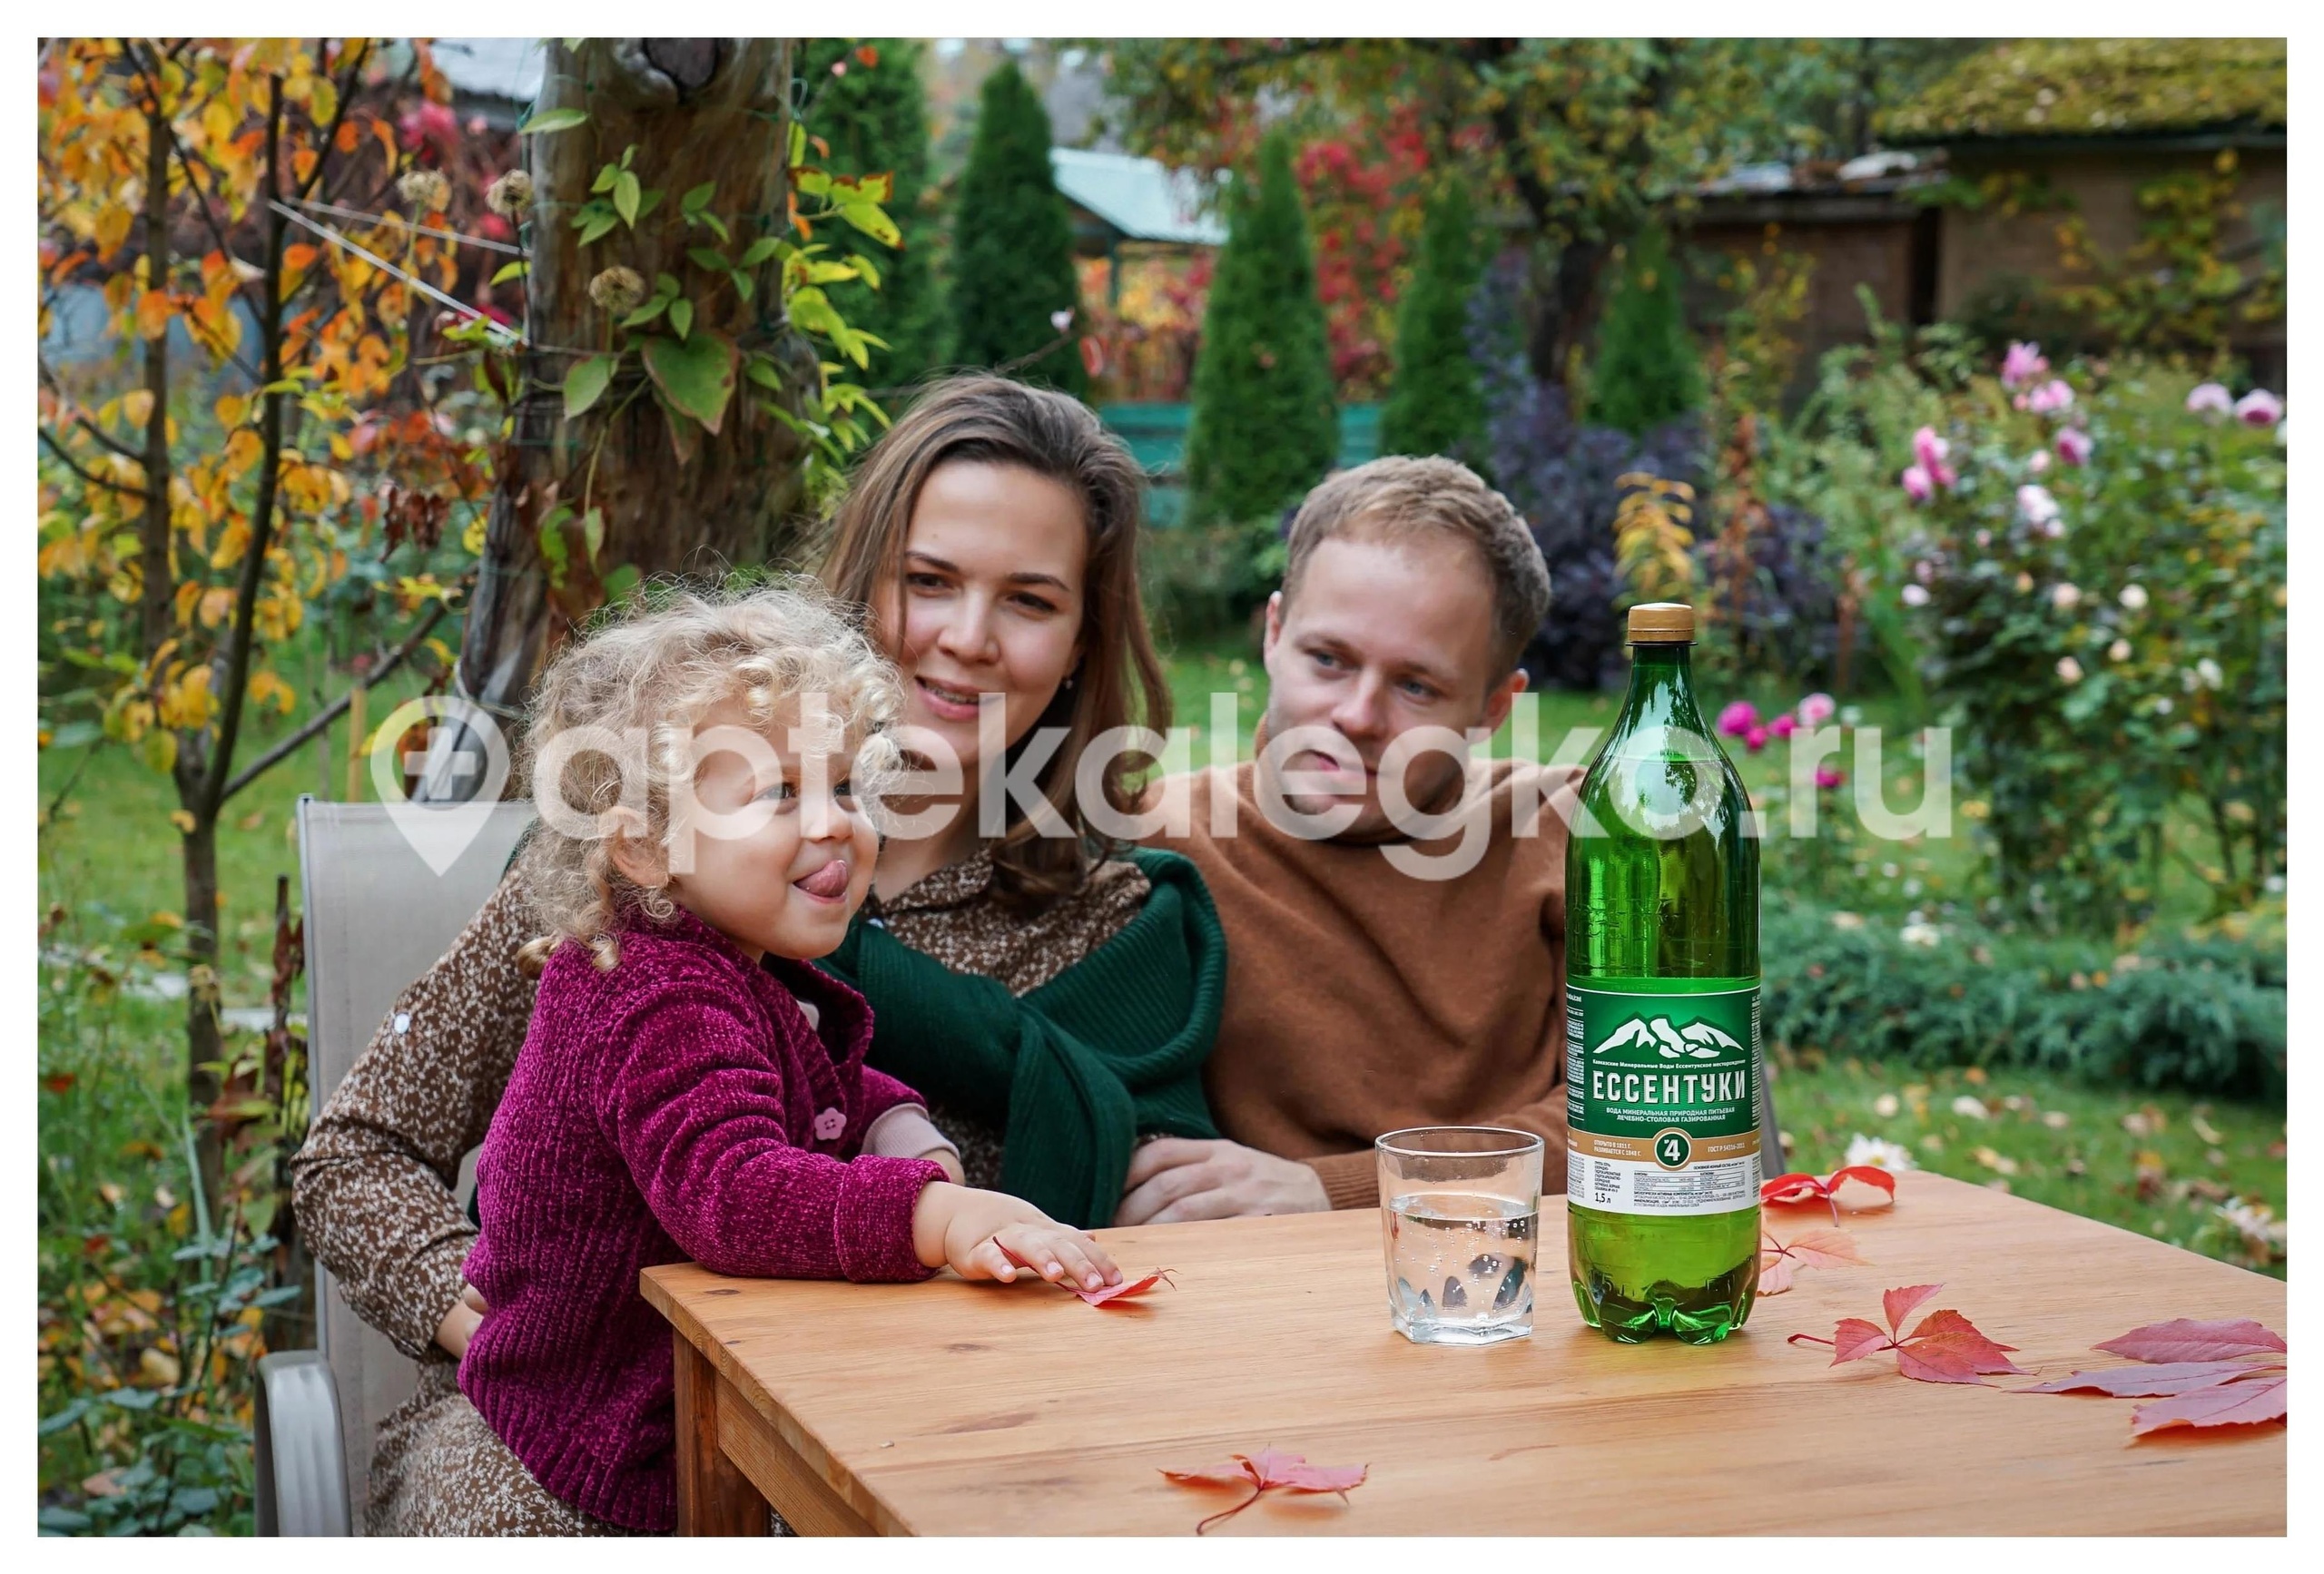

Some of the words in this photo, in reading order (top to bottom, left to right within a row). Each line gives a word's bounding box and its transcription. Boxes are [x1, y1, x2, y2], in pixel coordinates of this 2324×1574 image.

[1592, 1069, 1746, 1104] ЕССЕНТУКИ
[1606, 1107, 1622, 1115] ВОДА
[1622, 1108, 1669, 1117] МИНЕРАЛЬНАЯ
[1708, 1107, 1735, 1115] ПИТЬЕВАЯ
[1617, 1114, 1679, 1122] ЛЕЧЕБНО-СТОЛОВАЯ
[1681, 1115, 1726, 1123] ГАЗИРОВАННАЯ
[1595, 1192, 1605, 1204] 1,5
